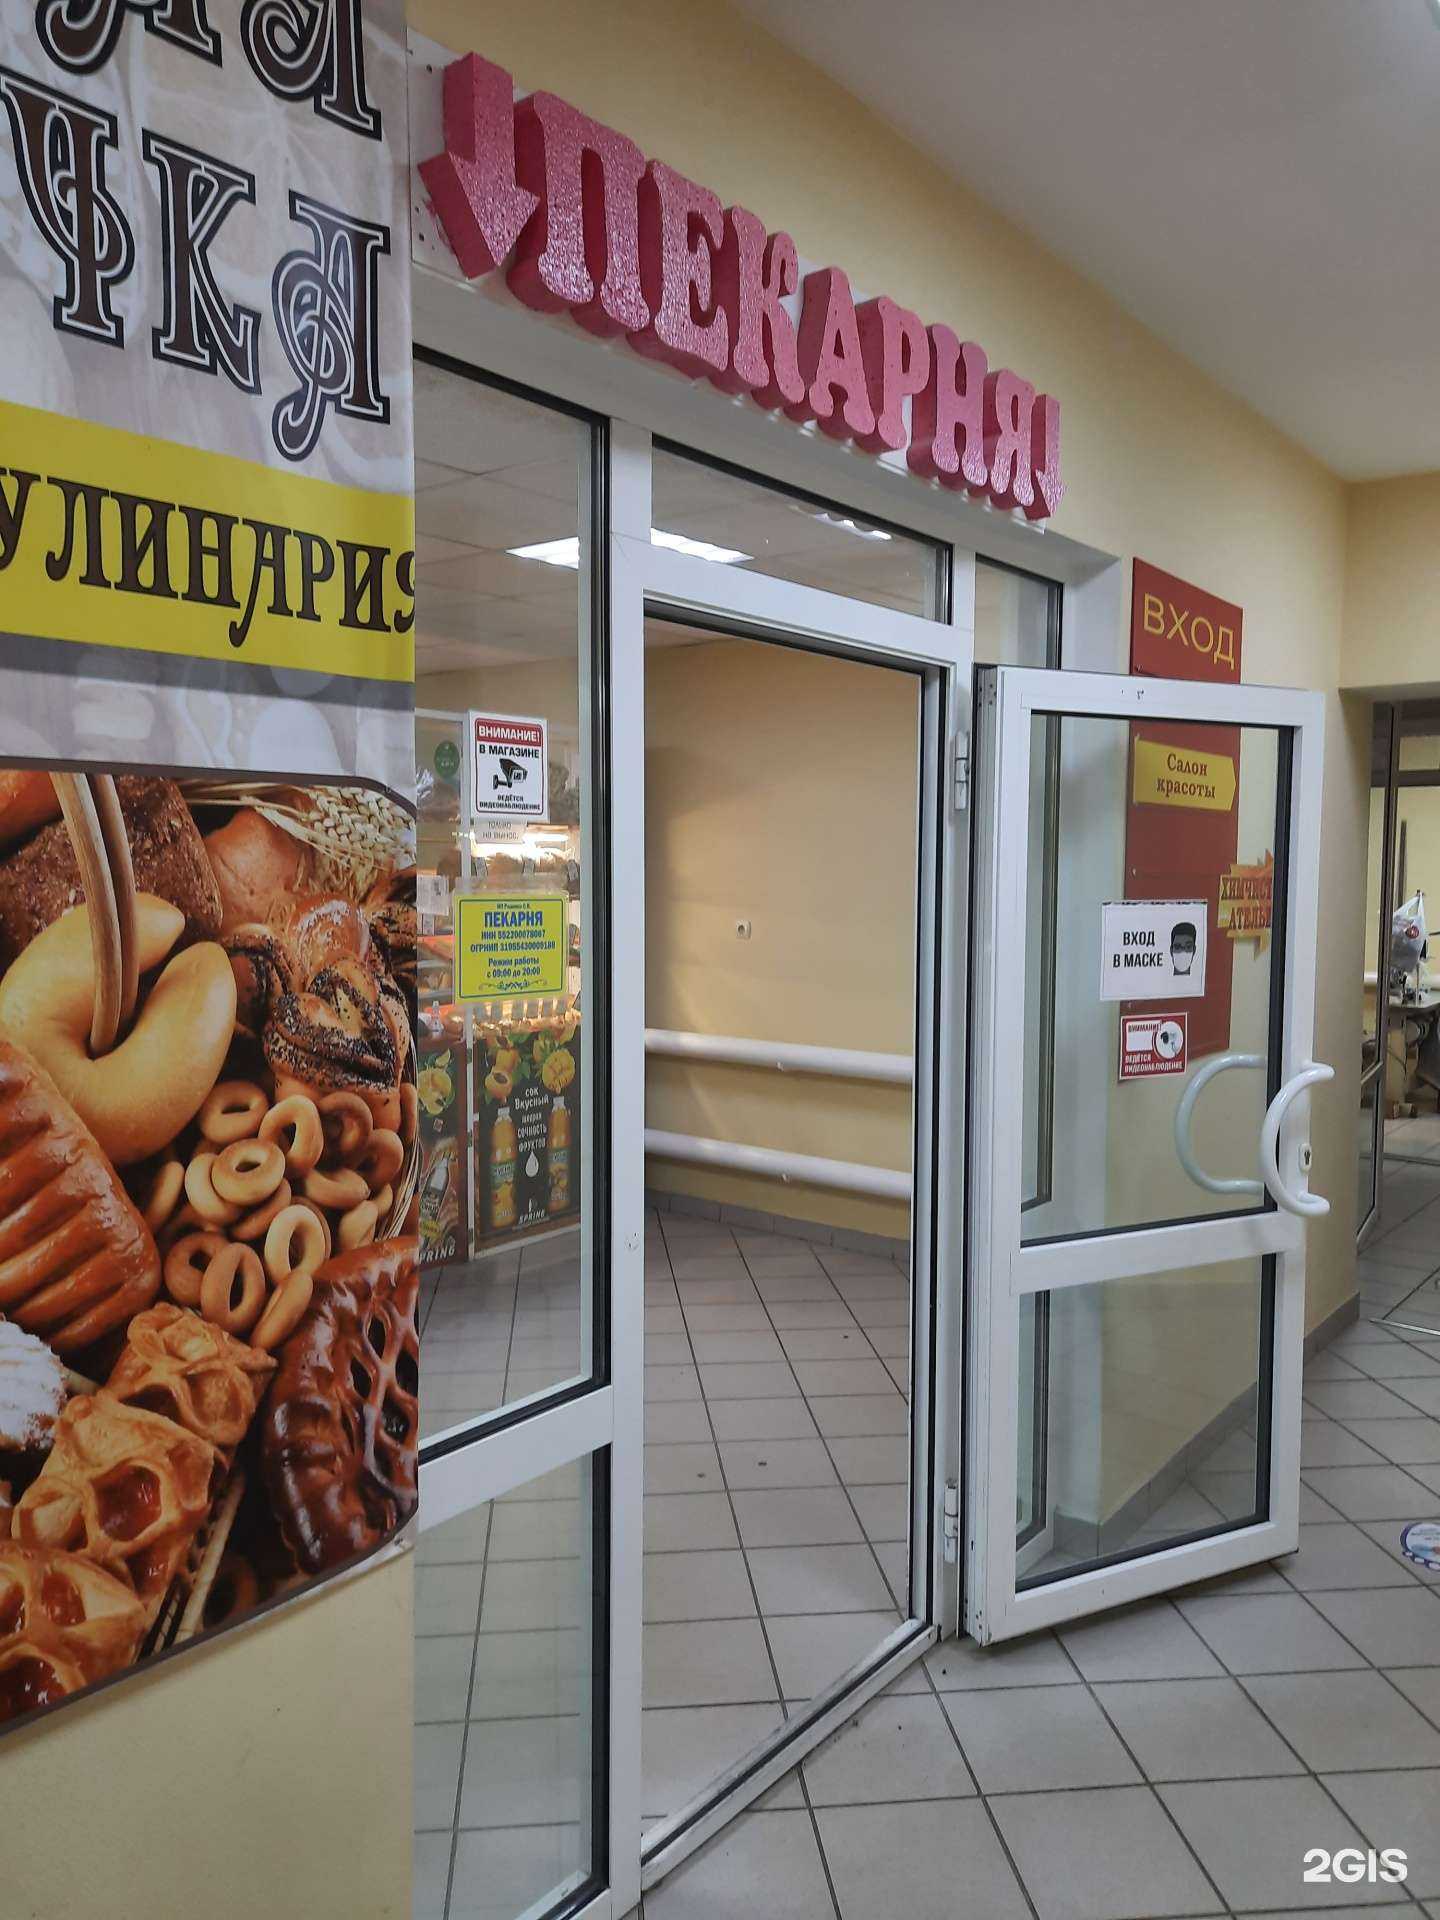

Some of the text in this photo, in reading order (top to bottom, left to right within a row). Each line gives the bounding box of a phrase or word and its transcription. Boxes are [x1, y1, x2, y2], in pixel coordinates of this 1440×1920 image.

[0, 467, 415, 648] УЛИНАРИ
[1142, 593, 1235, 671] ВХОД
[479, 726, 539, 742] ВНИМАНИЕ!
[479, 744, 540, 759] В МАГАЗИНЕ
[1166, 752, 1208, 777] Салон
[1156, 777, 1216, 800] красоты
[479, 802, 541, 811] ВИДЕОНАБЛЮДЕНИЕ
[484, 911, 543, 928] ПЕКАРНЯ
[481, 931, 496, 940] ИНН
[1122, 931, 1156, 948] ВХОД
[470, 944, 499, 952] ОГРНИП
[488, 956, 539, 968] Режим работы
[1113, 951, 1164, 968] В МАСКЕ
[513, 970, 521, 978] до
[417, 1247, 455, 1264] PRING
